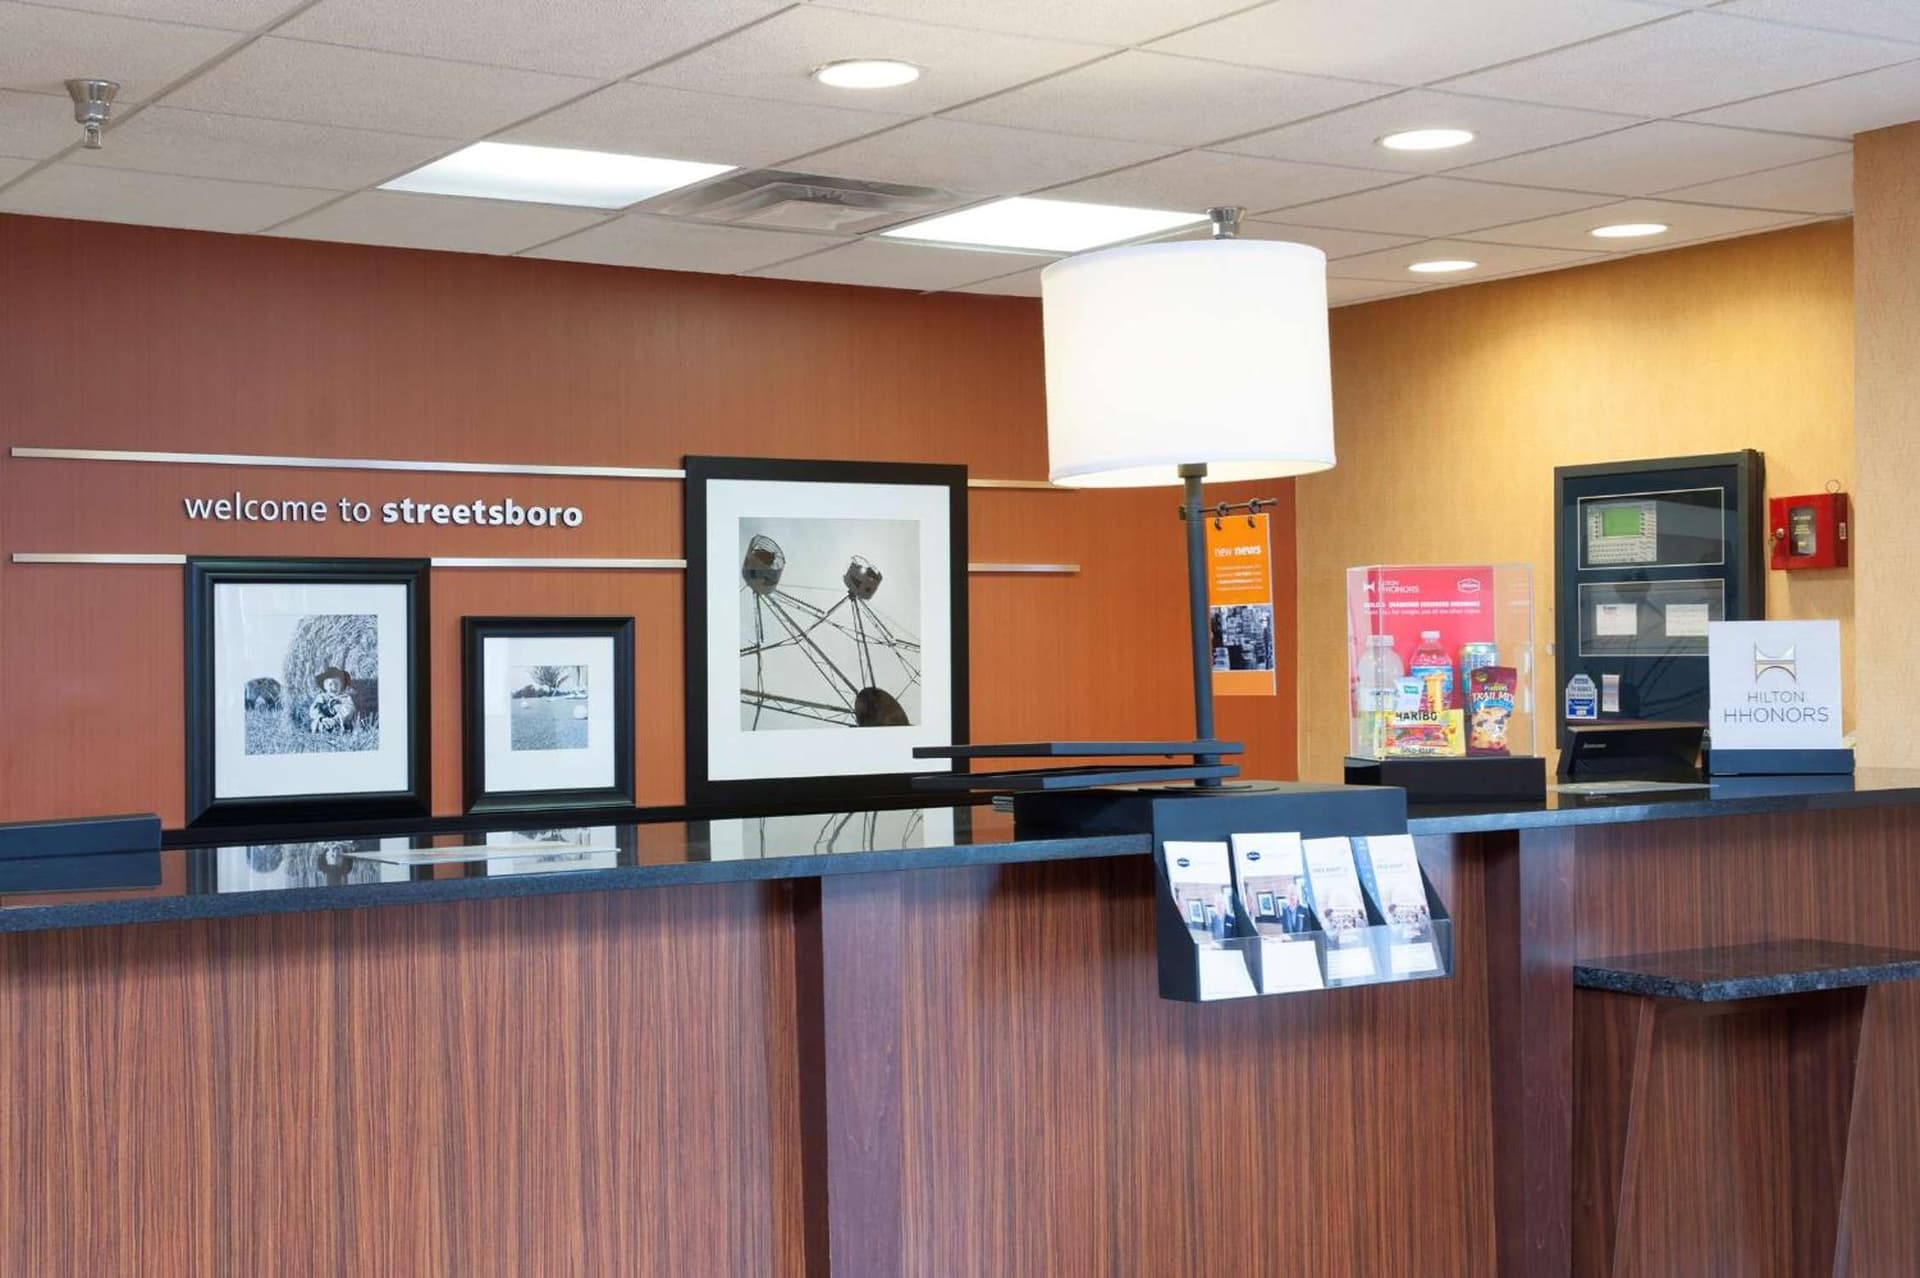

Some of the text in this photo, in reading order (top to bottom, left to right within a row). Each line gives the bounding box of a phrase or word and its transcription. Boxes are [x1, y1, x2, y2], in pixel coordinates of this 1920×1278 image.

[184, 492, 583, 528] welcome to streetsboro
[1748, 691, 1805, 703] HILTON
[1723, 707, 1829, 722] HHONORS
